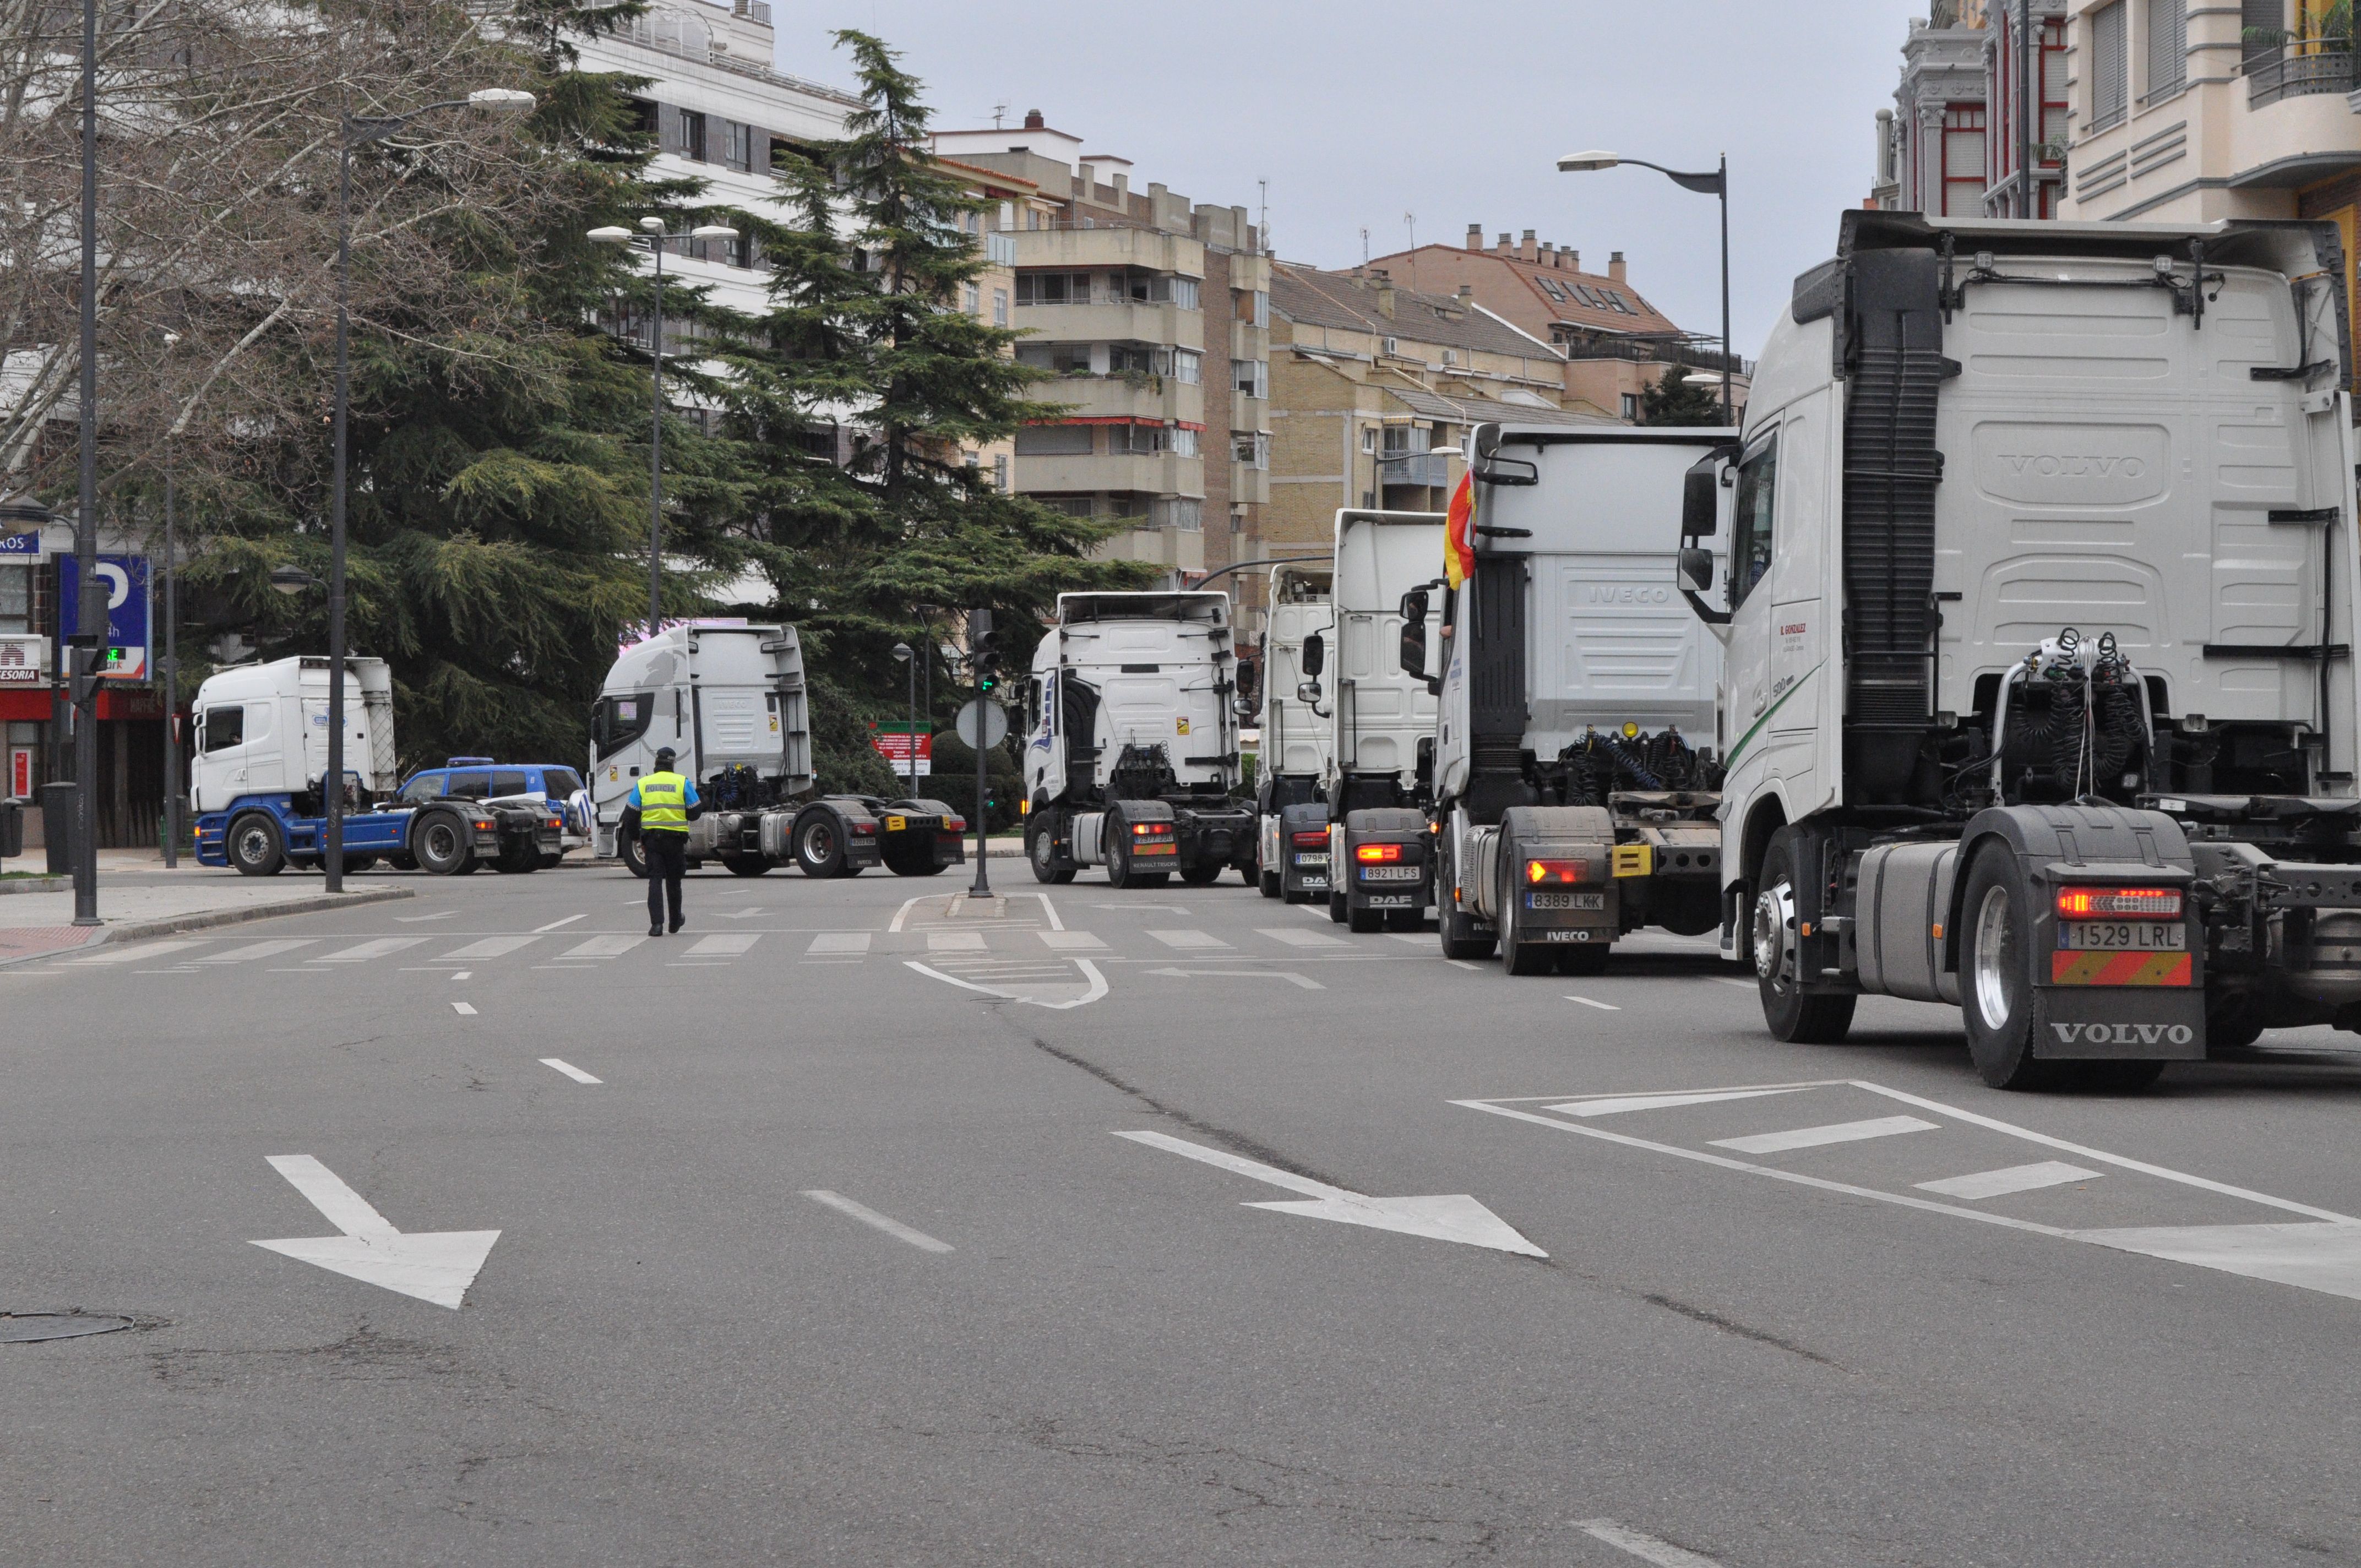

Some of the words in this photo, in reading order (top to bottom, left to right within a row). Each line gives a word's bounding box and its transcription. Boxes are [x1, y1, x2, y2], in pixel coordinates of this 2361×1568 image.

[1998, 455, 2146, 478] VOLVO
[1590, 587, 1668, 603] IVECO
[0, 670, 35, 680] ESORIA
[1368, 868, 1392, 878] 8921
[1397, 868, 1417, 878] LFS
[1369, 895, 1412, 904] DAF
[1534, 894, 1569, 907] 8389
[1574, 895, 1600, 908] LKK
[1547, 931, 1589, 941] IVECO
[2078, 925, 2130, 946] 1529
[2139, 926, 2178, 946] LRL
[2050, 1022, 2193, 1044] VOLVO
